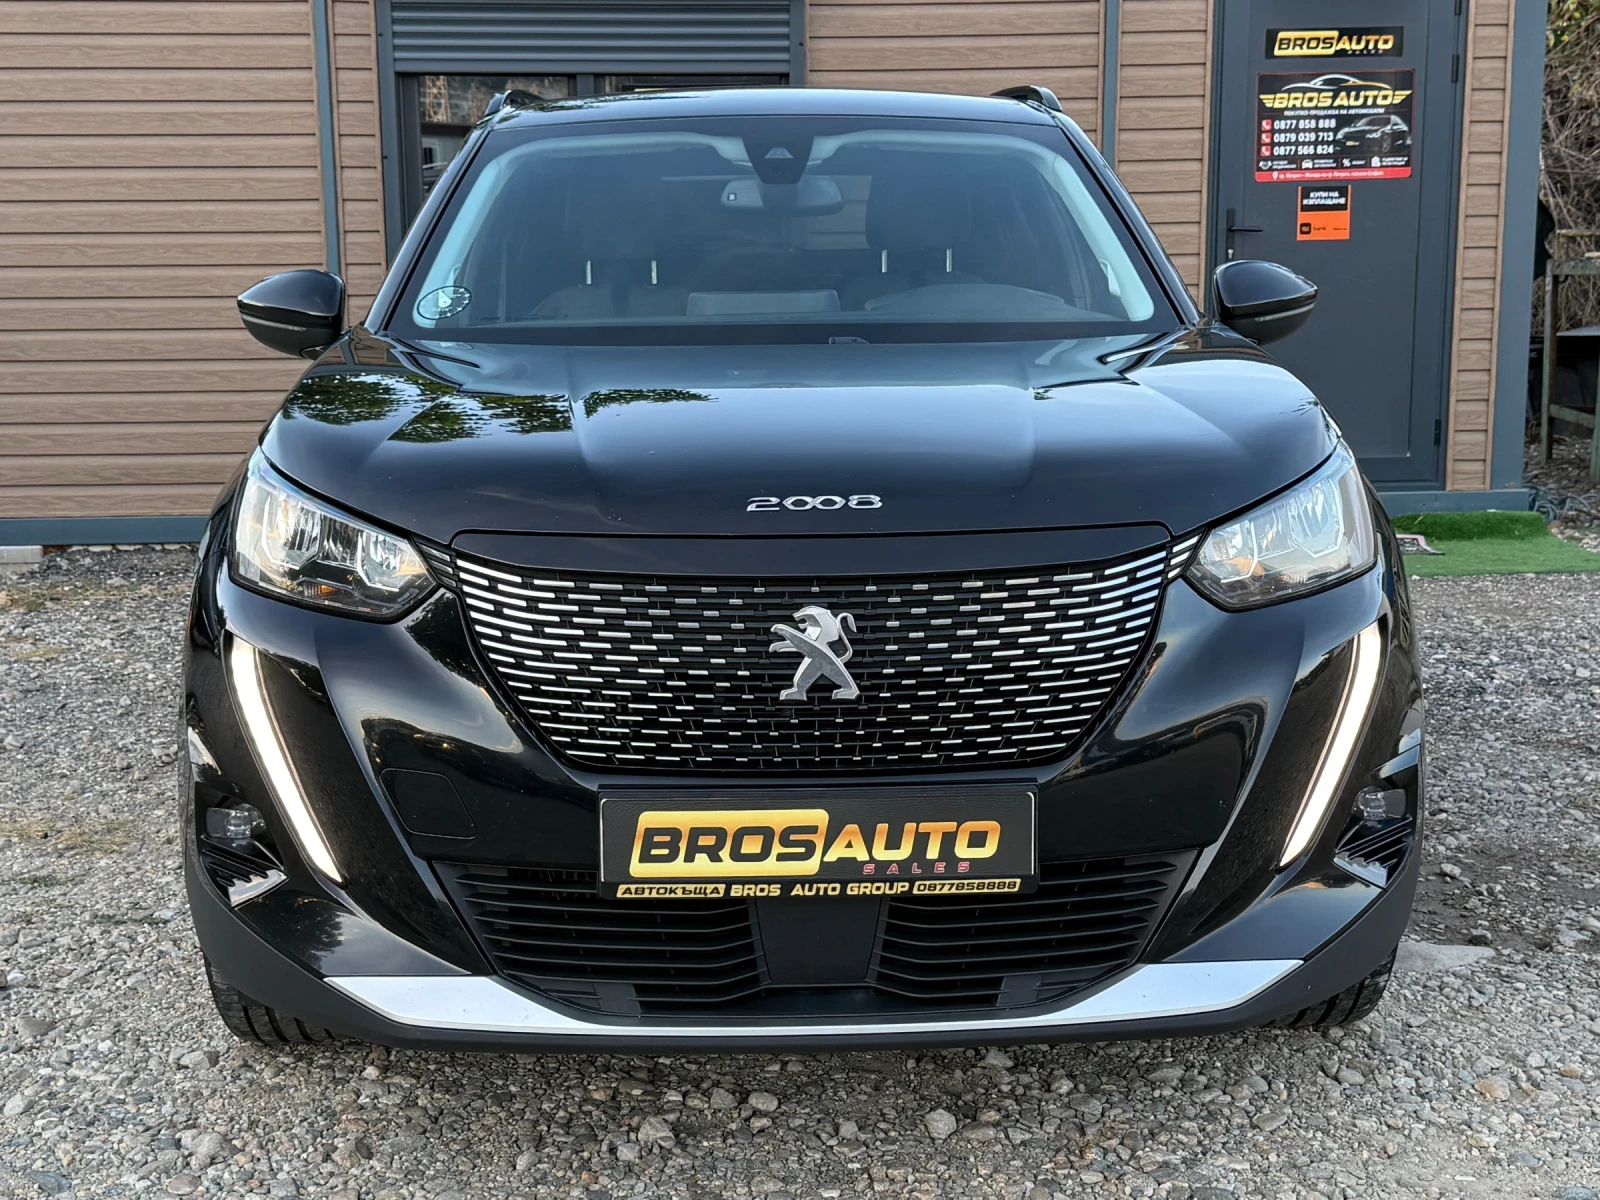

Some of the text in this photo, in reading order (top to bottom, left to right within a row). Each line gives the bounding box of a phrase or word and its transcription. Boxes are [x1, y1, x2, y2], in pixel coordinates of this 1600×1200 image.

[1277, 35, 1394, 50] BROS AUTO
[1273, 90, 1394, 109] BROS AUTO
[1273, 118, 1336, 130] 0877 858 888
[1273, 132, 1335, 143] 0879 039 713
[1273, 145, 1334, 156] 0877 566 824
[1303, 197, 1346, 205] ИЗПЛАЩАНЕ
[746, 494, 883, 512] 2008
[638, 820, 1001, 863] BROS AUTO
[863, 861, 970, 875] SALES
[621, 881, 1018, 897] АВТОКЪЩА BROS AUTO GROUP 0877858888
